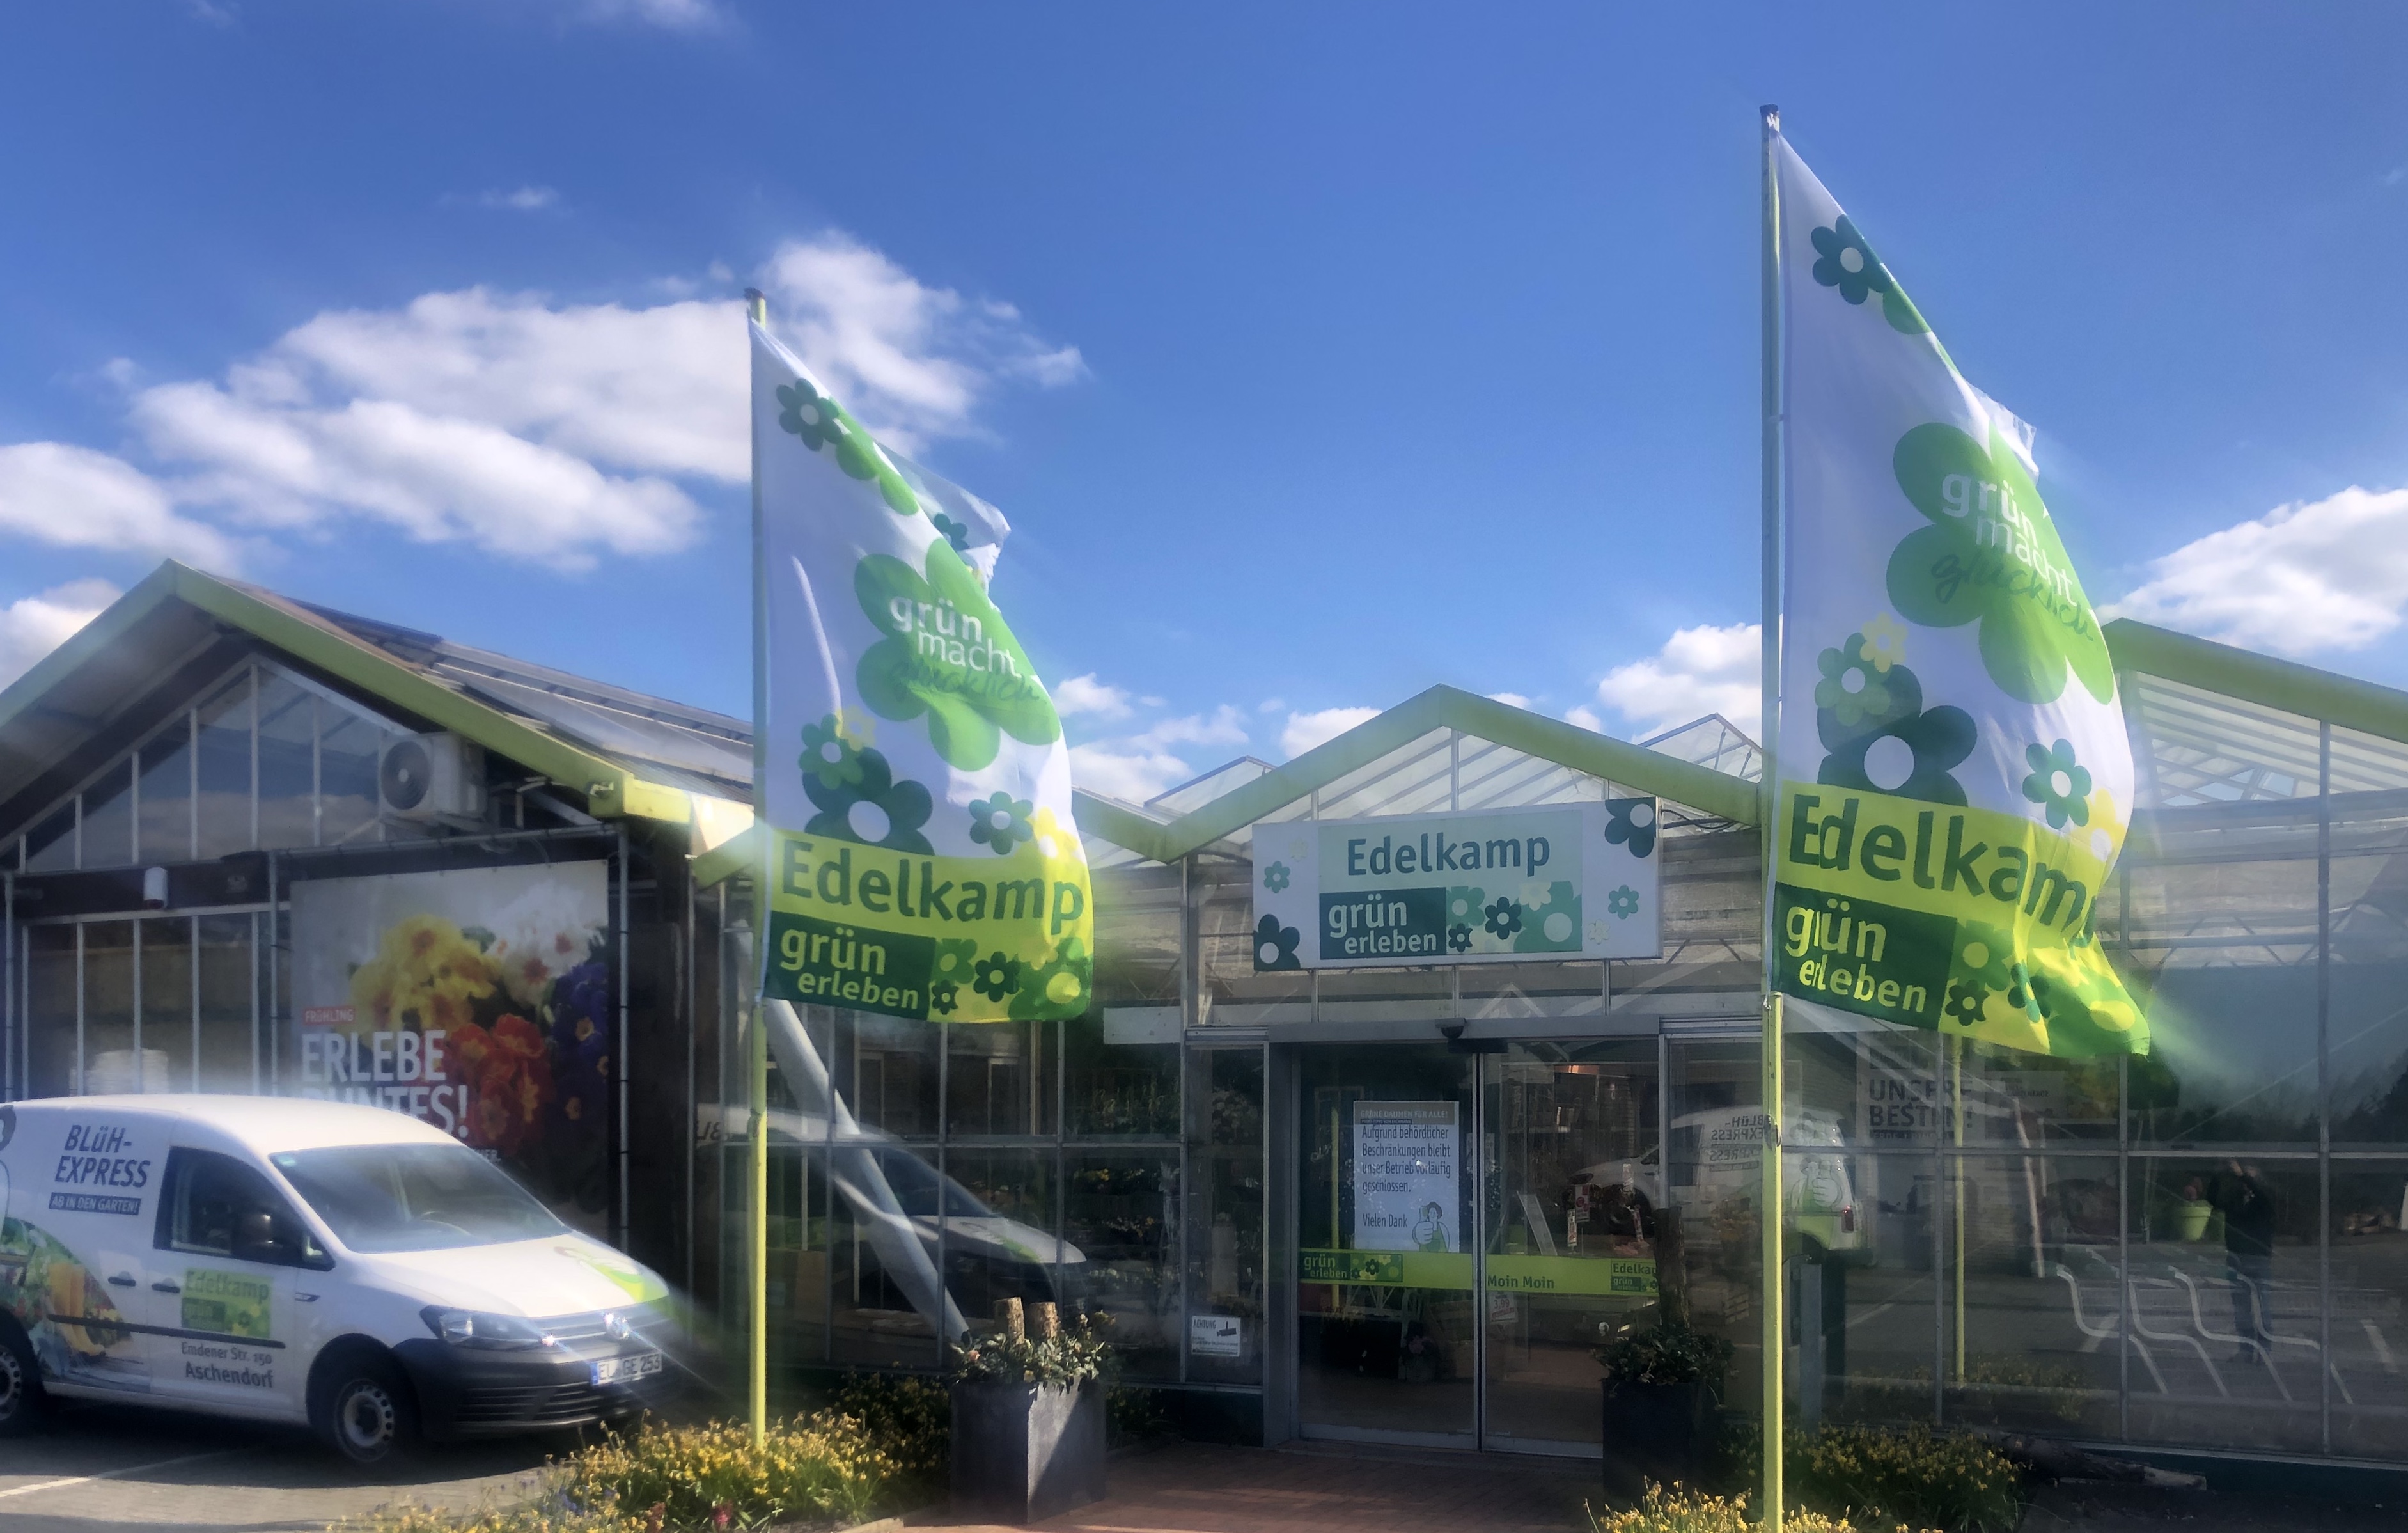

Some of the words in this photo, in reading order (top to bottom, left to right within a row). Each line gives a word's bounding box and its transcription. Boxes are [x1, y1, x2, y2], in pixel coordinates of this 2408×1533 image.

[1942, 473, 2038, 549] grün
[1976, 516, 2078, 607] macht
[889, 597, 982, 643] grün
[918, 631, 1022, 678] macht
[1347, 832, 1550, 876] Edelkamp
[783, 839, 1083, 934] Edelkamp
[1328, 893, 1407, 938] grün
[779, 927, 886, 975] grün
[1345, 928, 1437, 954] erleben
[797, 972, 919, 1010] erleben
[1799, 954, 1927, 1013] erleben
[302, 1030, 447, 1082] ERLEBE
[302, 1085, 469, 1138] TES!
[1362, 1125, 1397, 1142] Aufgrund
[1400, 1125, 1448, 1140] behördlicher
[1363, 1142, 1426, 1160] Beschränkungen
[1428, 1143, 1451, 1158] bleibt
[54, 1156, 151, 1188] EXPRESS
[1362, 1162, 1384, 1175] unser
[1386, 1160, 1414, 1175] Betrieb
[1416, 1161, 1451, 1179] vorläufig
[1363, 1180, 1411, 1195] geschlossen.
[52, 1195, 65, 1206] AB
[66, 1197, 75, 1207] IN
[77, 1197, 95, 1210] DEN
[98, 1198, 137, 1213] GARTEN!
[1363, 1213, 1386, 1228] Vielen
[1388, 1214, 1408, 1228] Dank
[1304, 1254, 1335, 1270] grün
[1310, 1269, 1347, 1278] erleben
[1613, 1263, 1656, 1274] Edelka
[1488, 1275, 1518, 1287] Moin
[1523, 1277, 1554, 1289] Moin
[1193, 1319, 1216, 1329] ACHTUNG
[182, 1342, 228, 1359] Emdener
[231, 1347, 250, 1362] Str.
[254, 1352, 272, 1366] 150
[185, 1361, 273, 1388] Aschendorf
